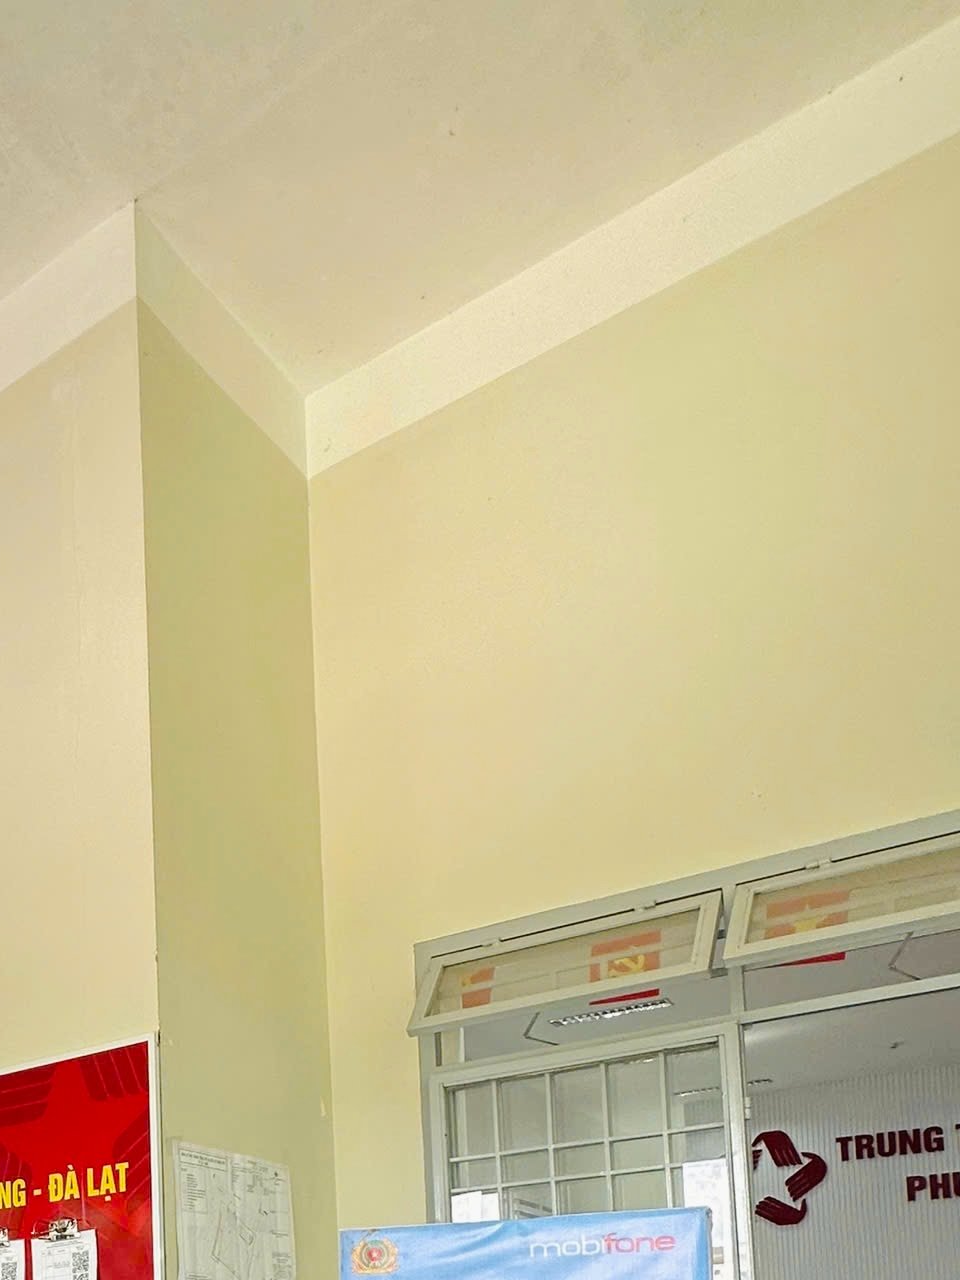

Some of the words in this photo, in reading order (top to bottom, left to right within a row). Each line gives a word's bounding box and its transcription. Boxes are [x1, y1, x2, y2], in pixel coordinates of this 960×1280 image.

[835, 1126, 945, 1162] TRUNG
[48, 1164, 80, 1203] ĐÀ
[86, 1161, 130, 1202] LẠT
[529, 1232, 677, 1259] mobifone
